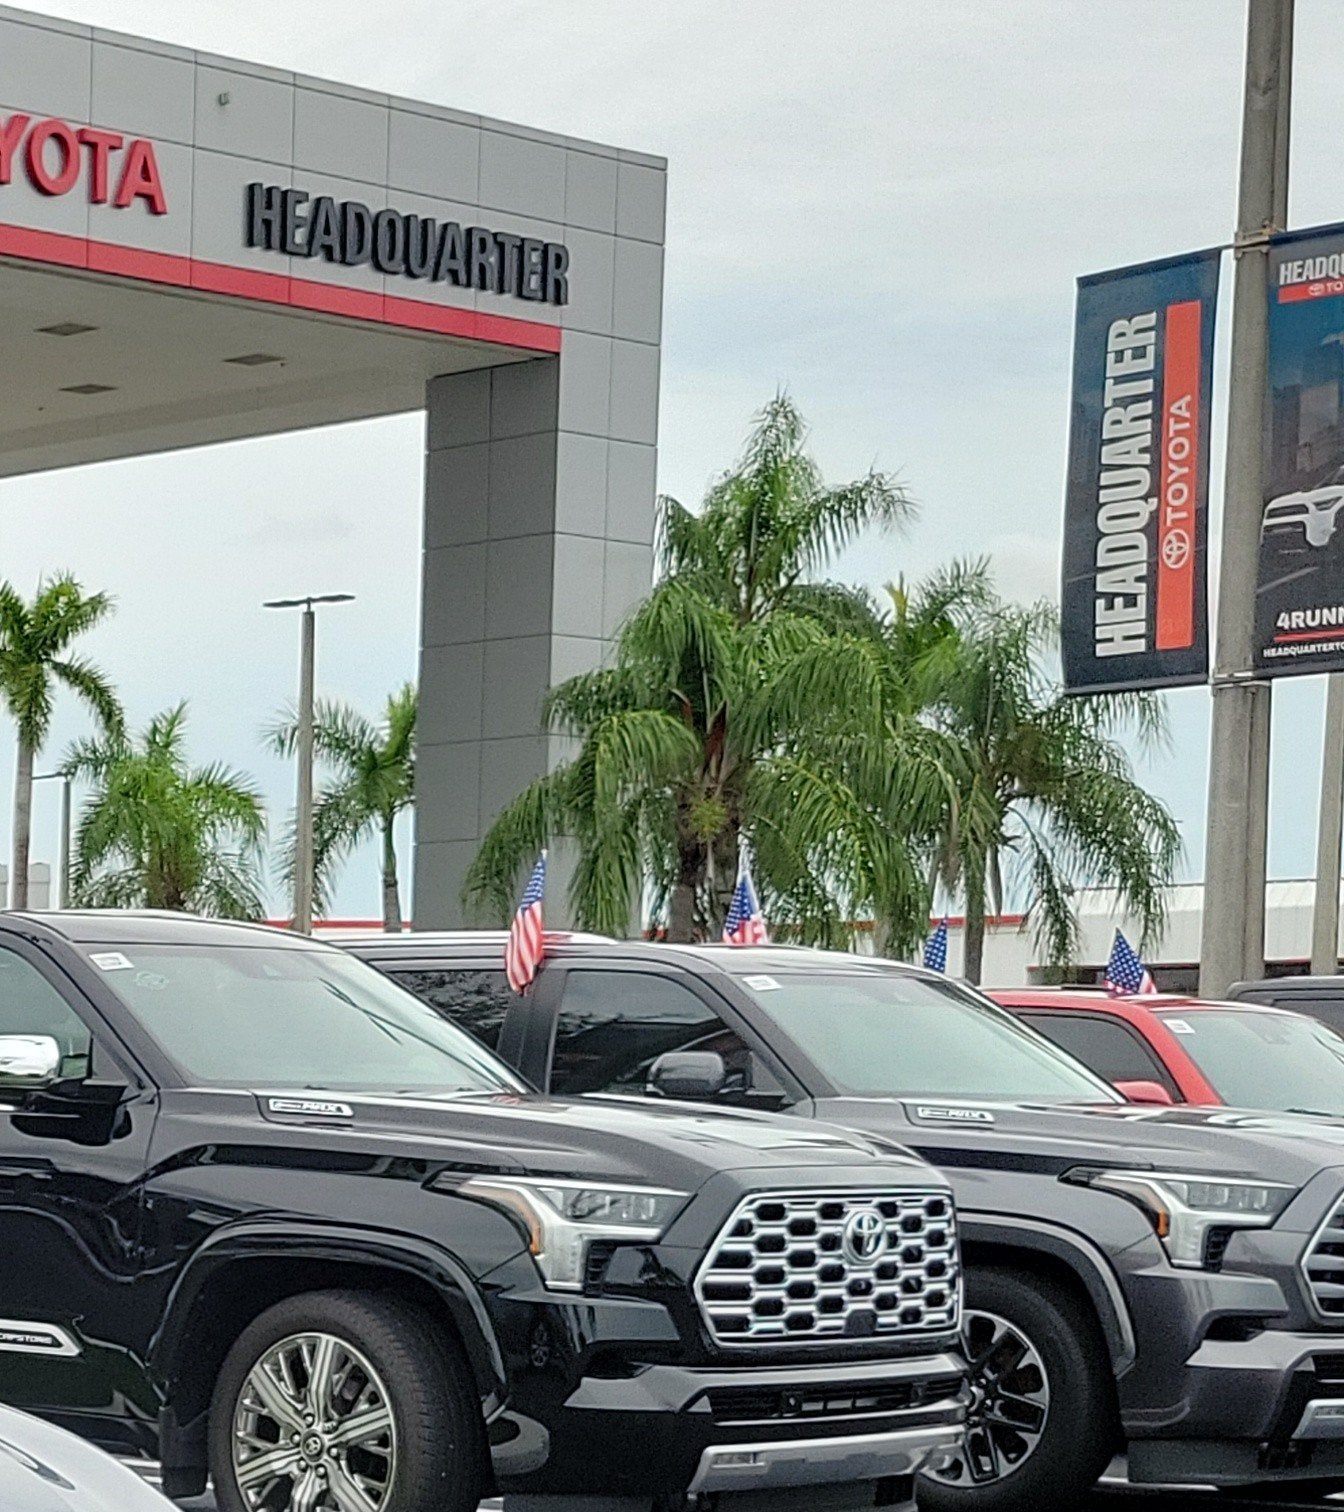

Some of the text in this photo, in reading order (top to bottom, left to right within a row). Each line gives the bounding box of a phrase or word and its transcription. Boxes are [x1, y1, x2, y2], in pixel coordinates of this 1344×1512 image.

[245, 182, 569, 306] HEADQUARTER
[1279, 252, 1344, 286] HEADQ
[1094, 310, 1158, 659] HEADQUARTER
[1165, 394, 1192, 527] TOYOTA
